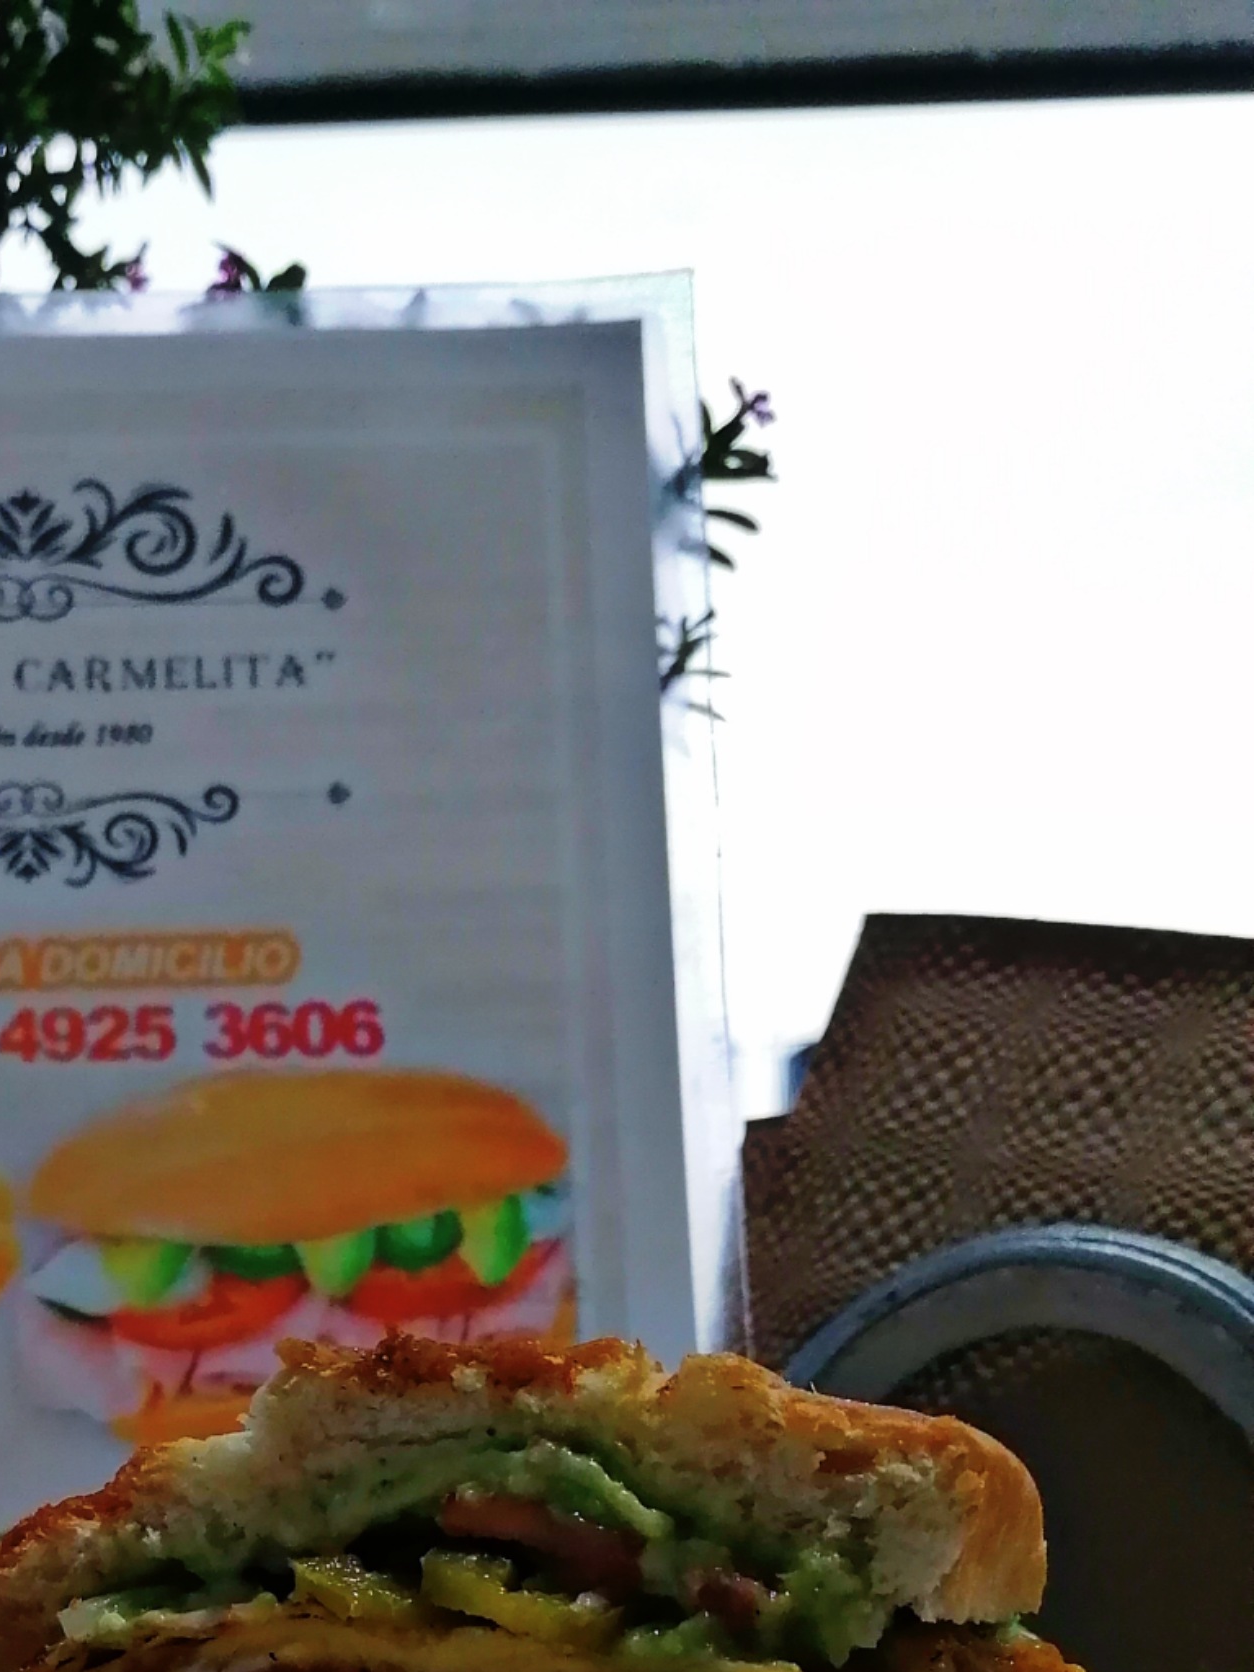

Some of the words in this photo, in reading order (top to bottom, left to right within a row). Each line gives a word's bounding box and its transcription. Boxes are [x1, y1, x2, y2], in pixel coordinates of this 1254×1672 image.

[22, 722, 86, 748] desde
[41, 939, 293, 983] DOMICILIO
[202, 998, 385, 1059] 3606
